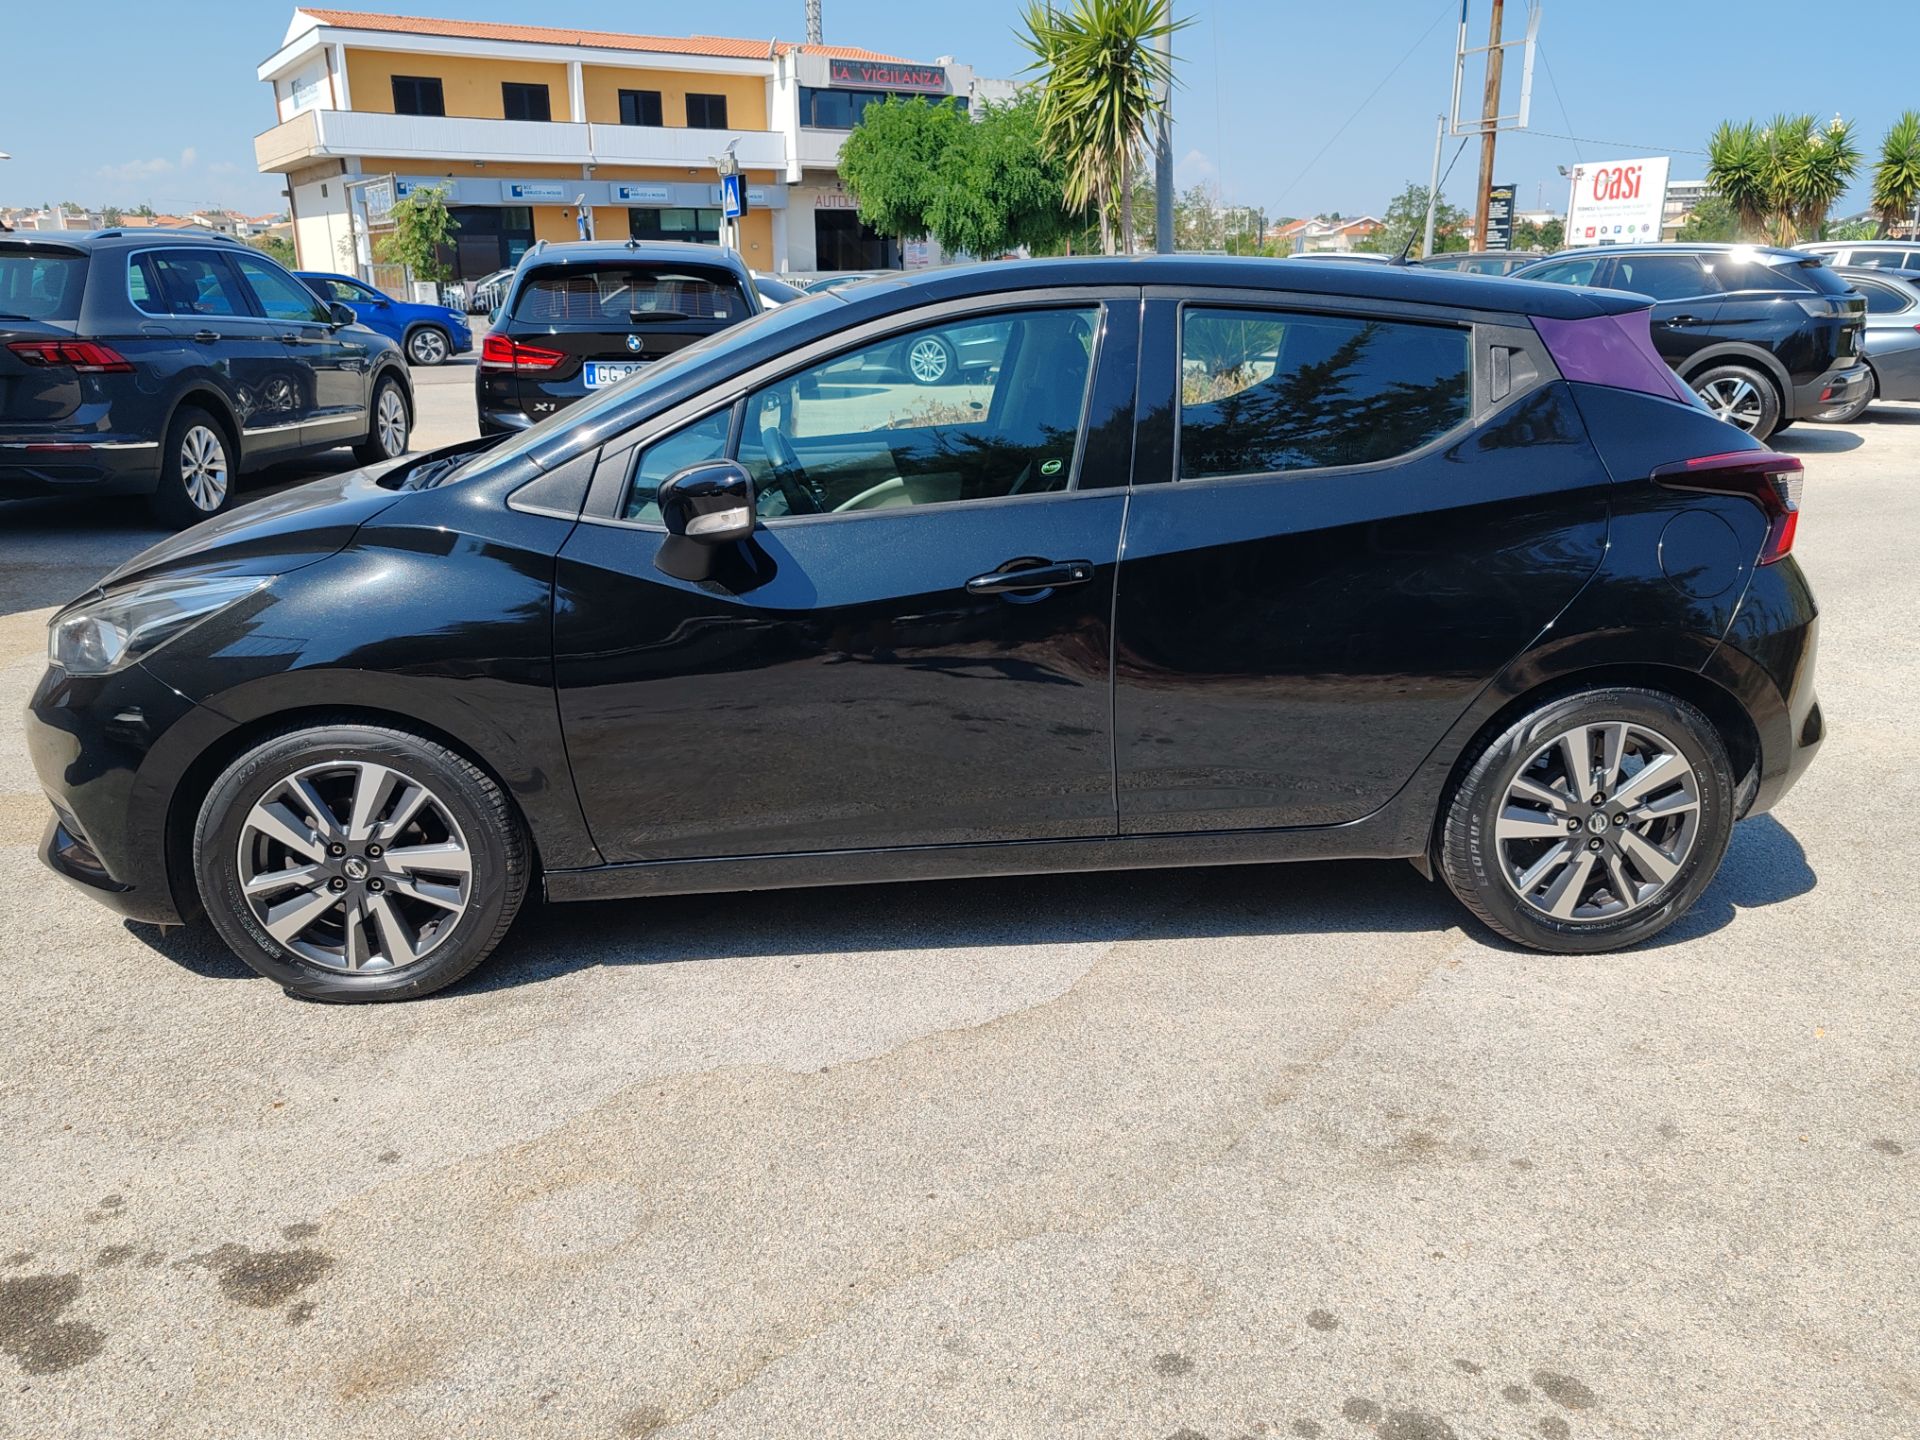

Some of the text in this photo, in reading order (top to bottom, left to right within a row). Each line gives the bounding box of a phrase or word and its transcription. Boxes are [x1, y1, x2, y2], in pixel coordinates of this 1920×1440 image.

[832, 66, 943, 85] LA VIGILANZA
[598, 365, 618, 382] GG
[533, 402, 556, 412] X1
[1470, 813, 1489, 887] ECOPLUS
